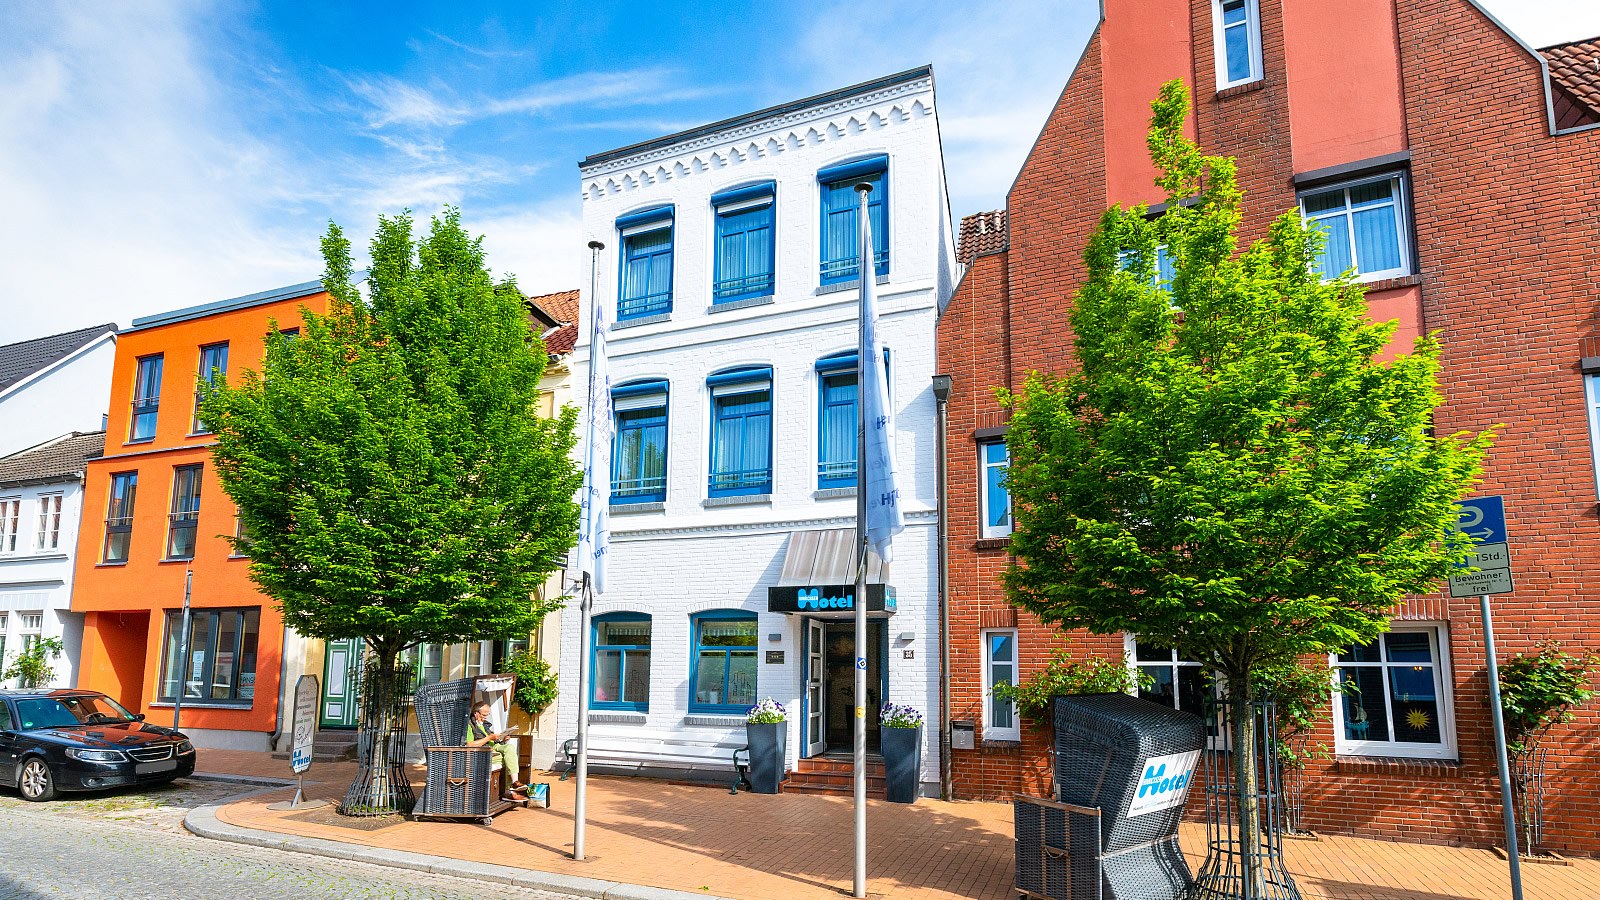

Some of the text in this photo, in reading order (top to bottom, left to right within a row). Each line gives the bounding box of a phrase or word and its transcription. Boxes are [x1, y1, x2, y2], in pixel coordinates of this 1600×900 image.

[1482, 552, 1503, 562] Std.
[1455, 572, 1503, 583] Bewohner
[1473, 584, 1490, 593] frei
[798, 588, 853, 609] Hotel
[1138, 763, 1192, 799] Hotel
